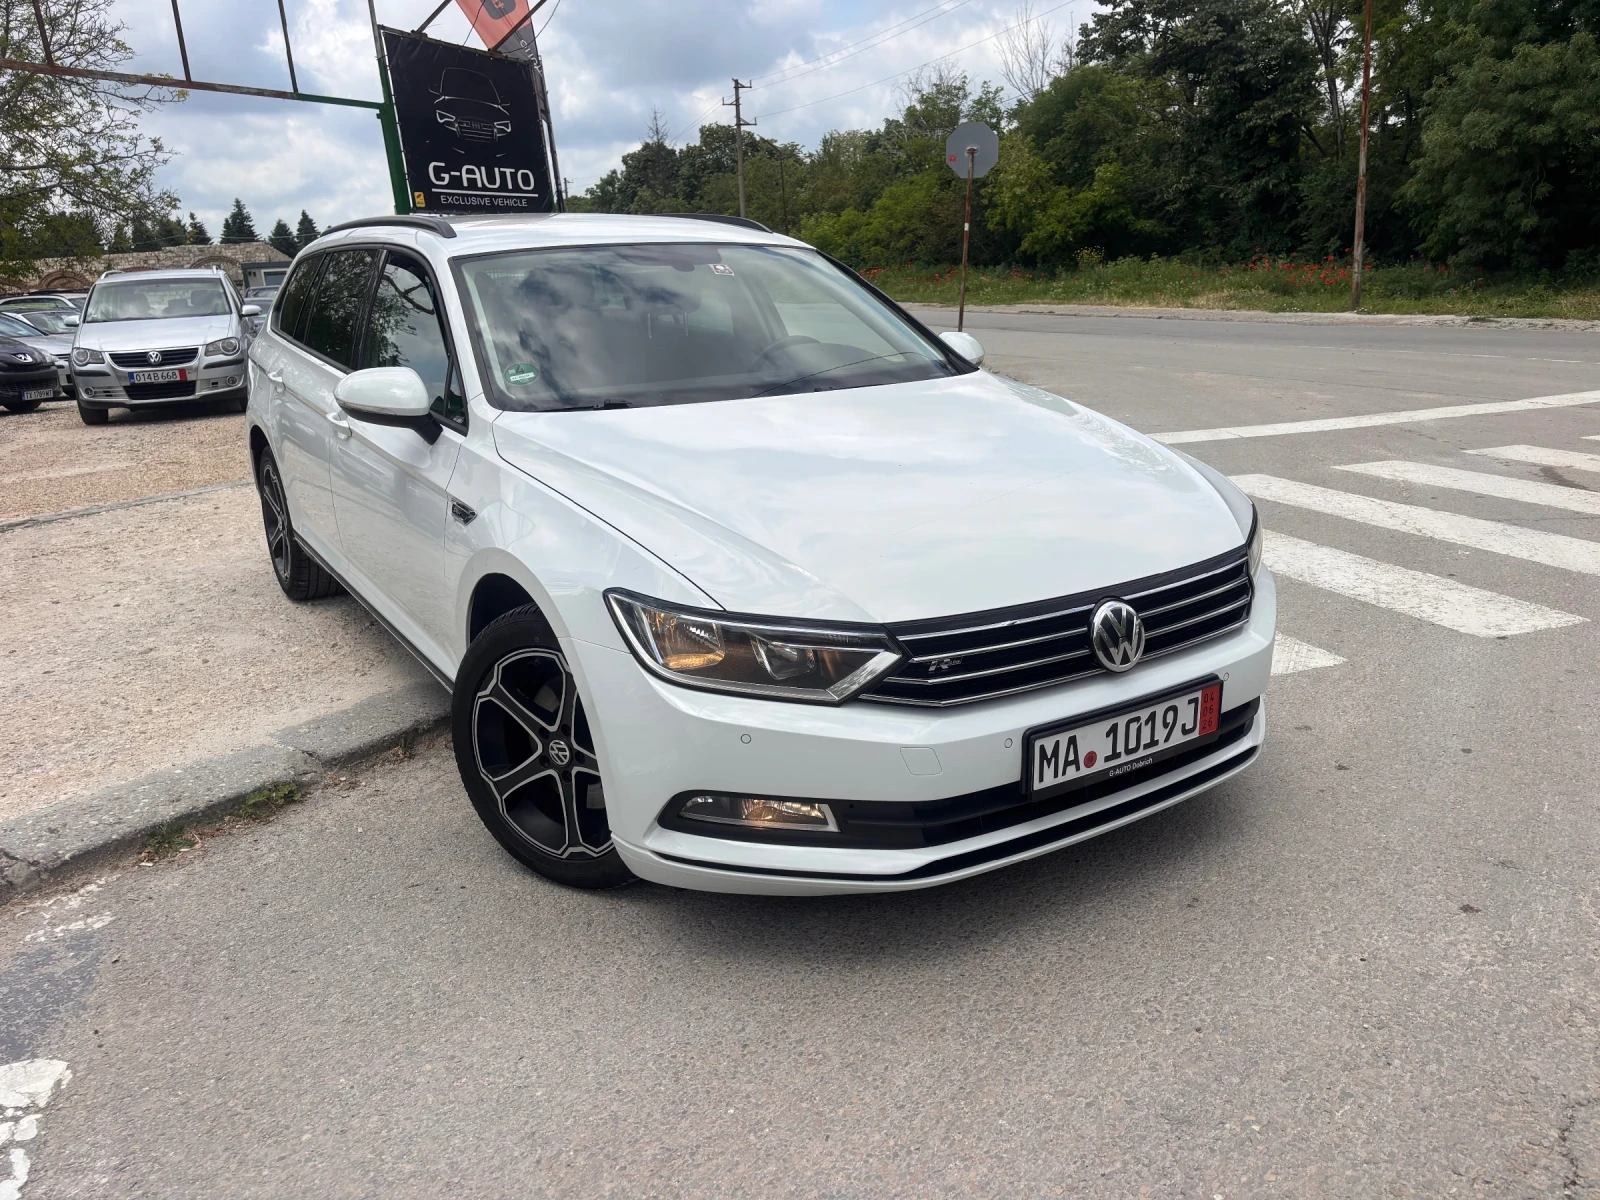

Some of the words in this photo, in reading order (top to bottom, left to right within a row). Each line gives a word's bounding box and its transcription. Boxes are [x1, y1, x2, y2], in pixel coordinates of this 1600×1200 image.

[428, 161, 535, 190] G-AUTO
[440, 195, 491, 206] EXCLUSIVE
[493, 198, 528, 207] VEHICLE
[1203, 692, 1214, 703] 04
[1203, 705, 1213, 716] 06
[1202, 717, 1212, 729] 26
[1038, 734, 1081, 783] MA
[1132, 757, 1153, 770] Dobrich
